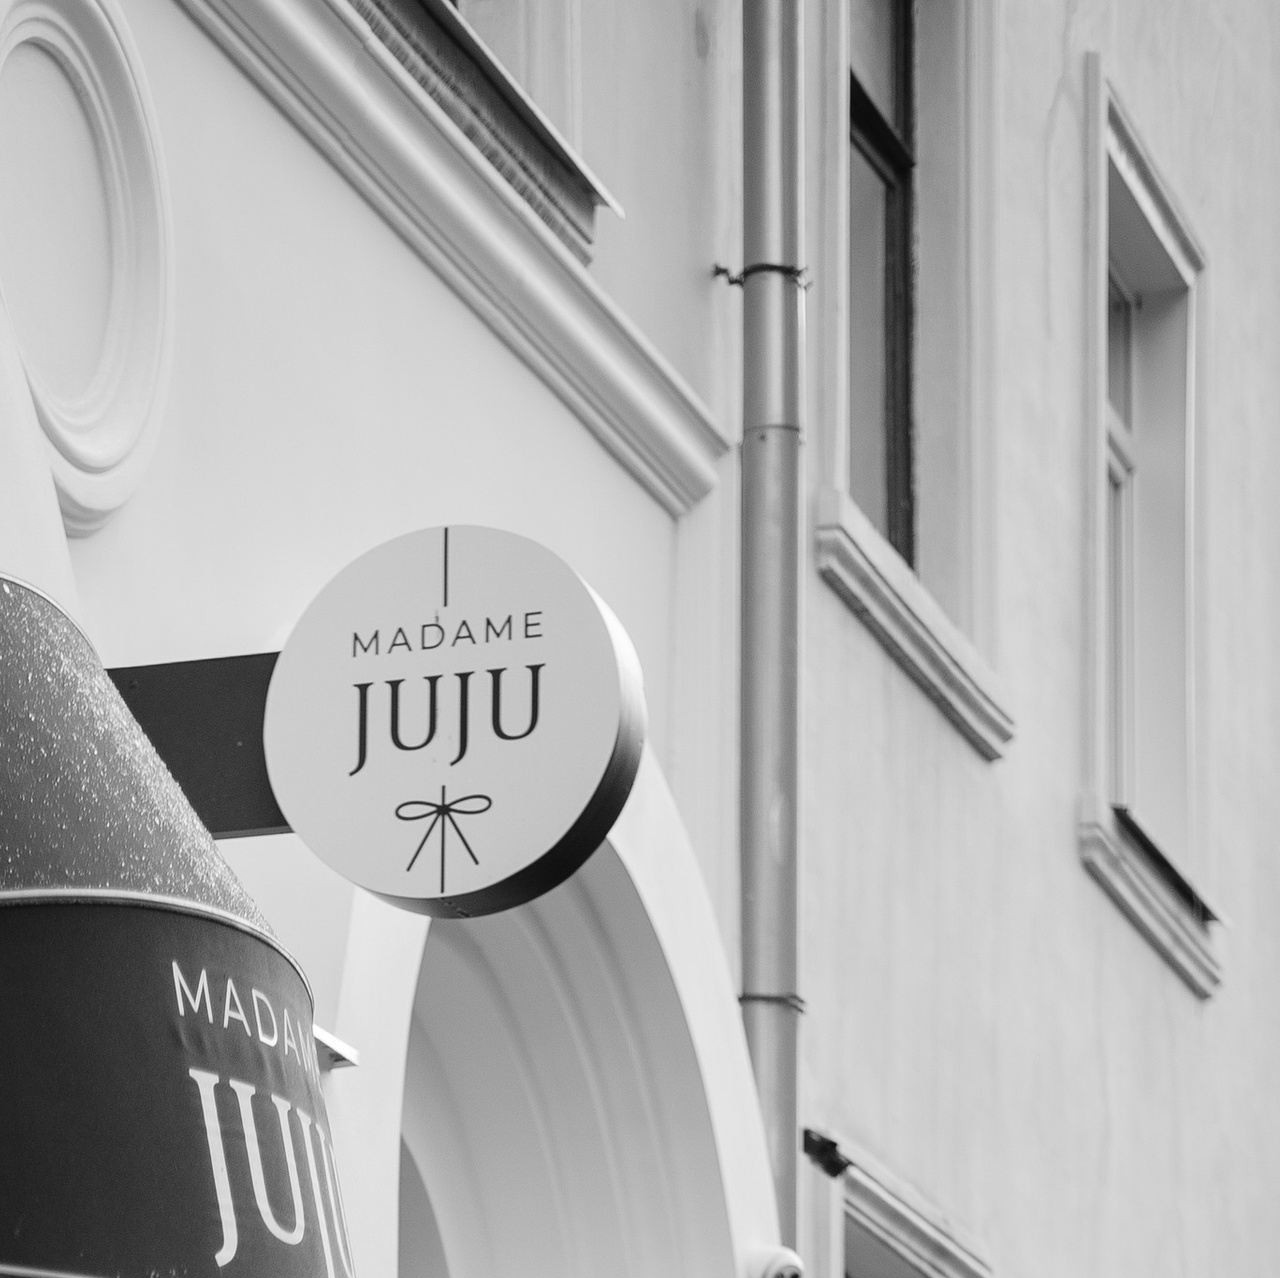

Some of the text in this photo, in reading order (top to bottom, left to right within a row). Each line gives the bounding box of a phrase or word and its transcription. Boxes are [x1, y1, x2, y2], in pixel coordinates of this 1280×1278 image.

[352, 611, 544, 658] MADAME
[348, 663, 546, 777] JUJU
[172, 960, 323, 1100] MADAM
